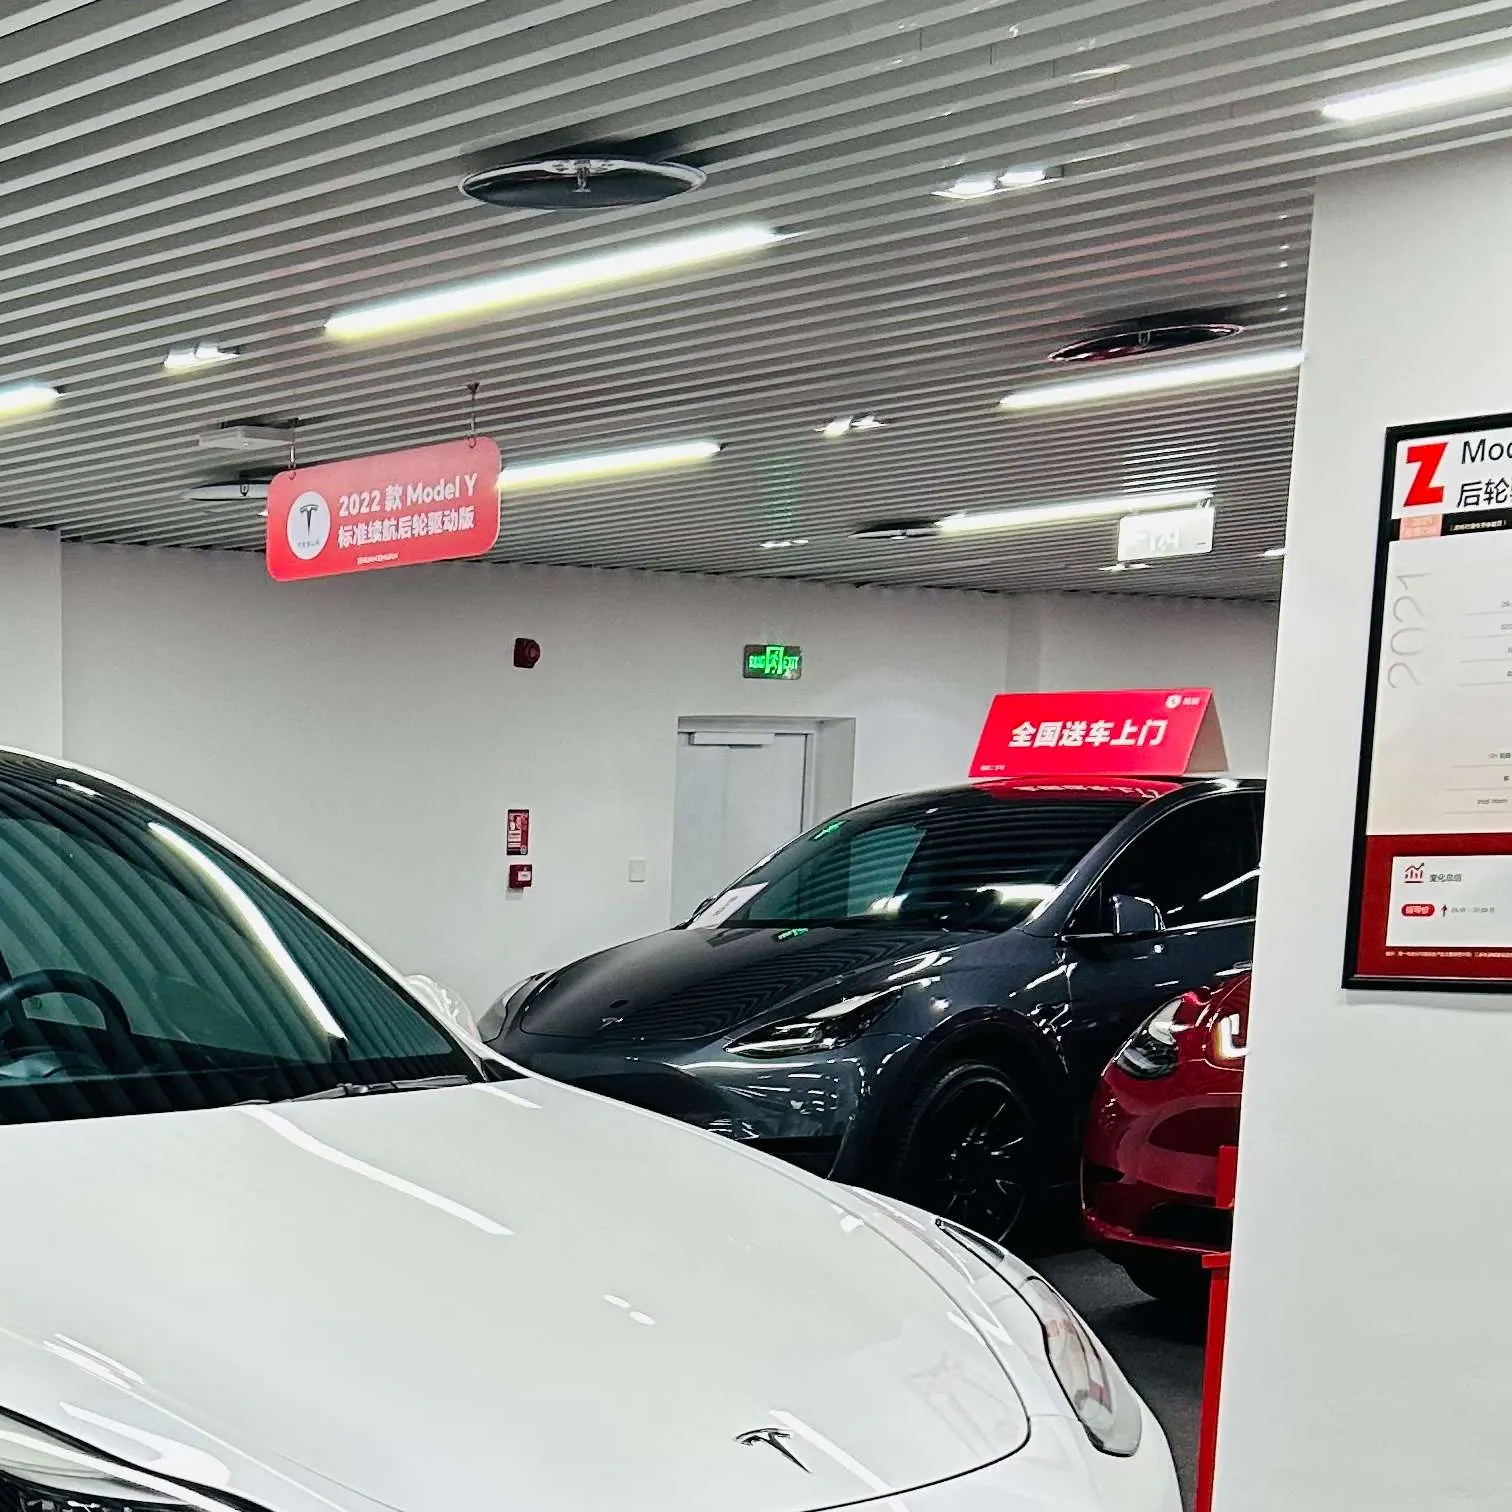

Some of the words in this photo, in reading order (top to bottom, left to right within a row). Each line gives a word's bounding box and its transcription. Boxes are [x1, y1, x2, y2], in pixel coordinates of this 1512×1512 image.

[338, 490, 381, 517] 2022
[384, 484, 403, 512] 款
[406, 476, 460, 506] Model
[464, 473, 478, 497] Y
[1456, 477, 1512, 509] 后轮
[338, 506, 475, 549] 标准续航后轮驱动版
[1386, 571, 1434, 689] 2021
[1008, 719, 1168, 748] 全国送车上门
